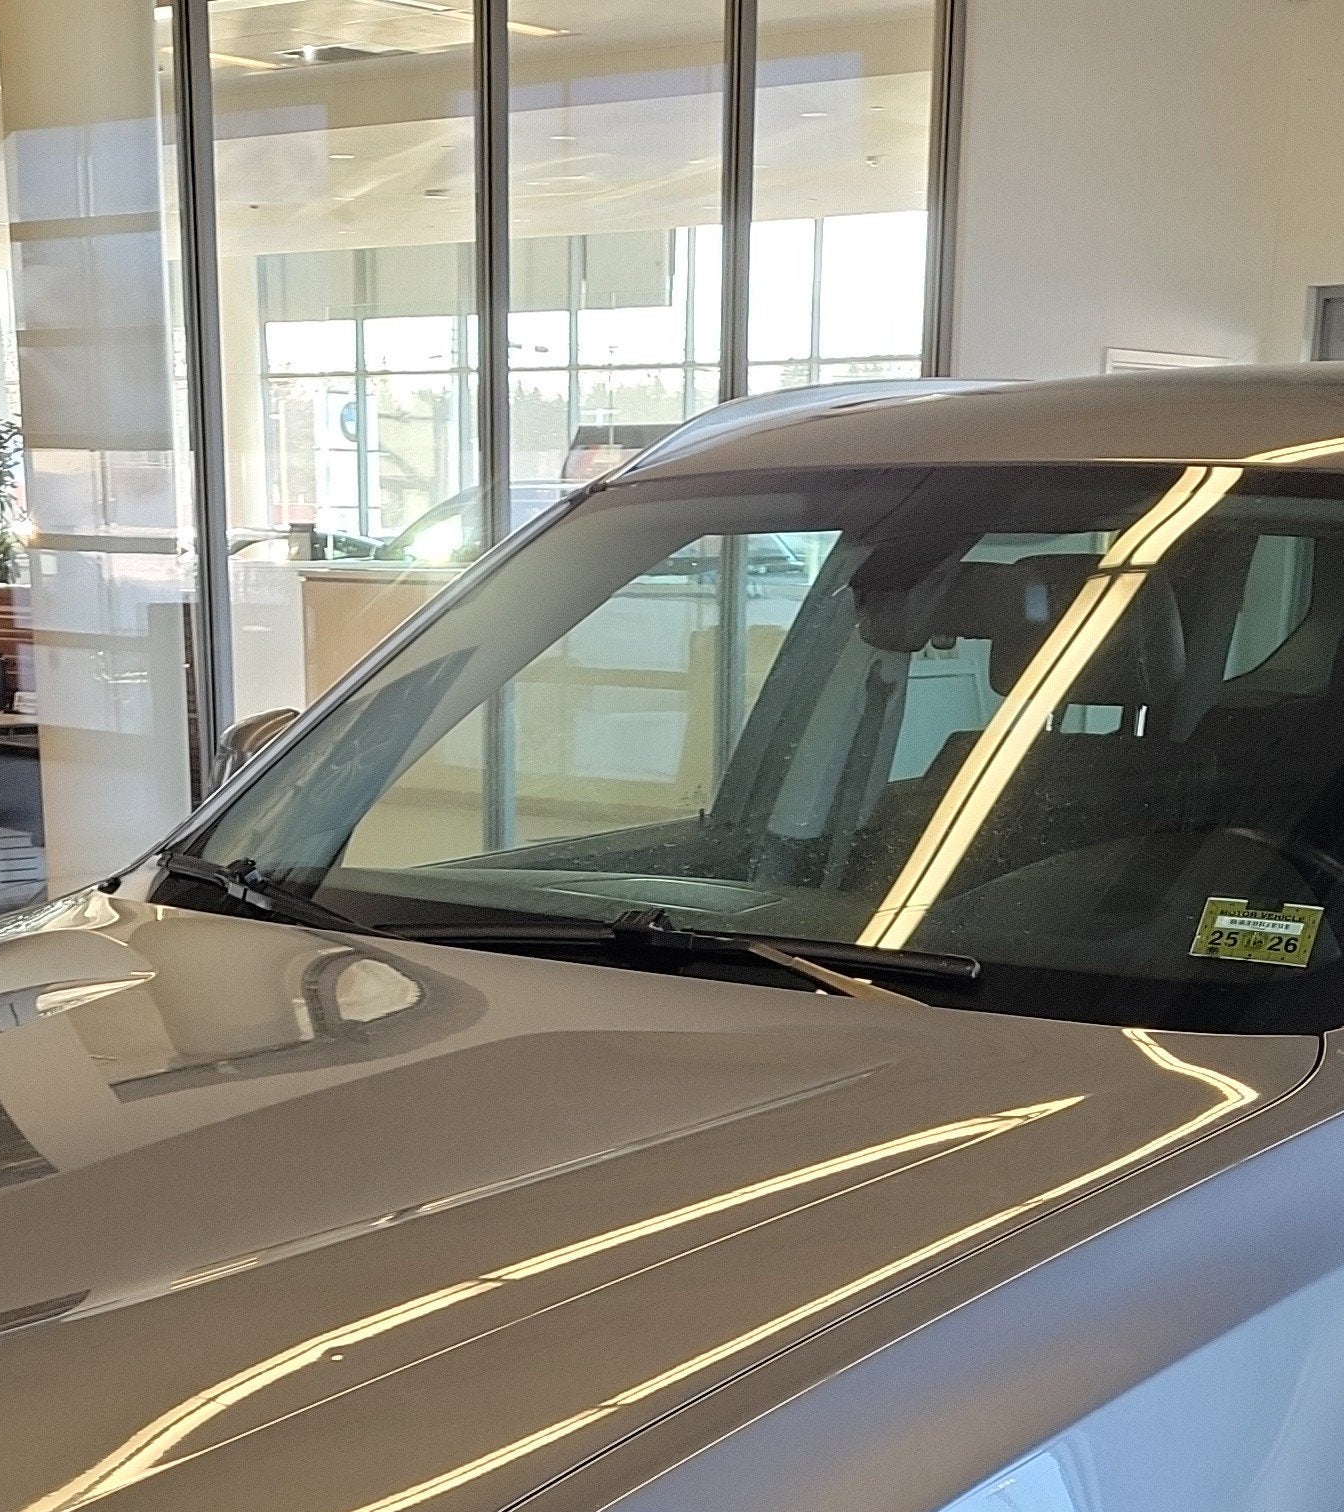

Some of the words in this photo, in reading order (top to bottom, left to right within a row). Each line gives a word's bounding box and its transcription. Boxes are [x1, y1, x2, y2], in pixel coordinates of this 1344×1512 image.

[1219, 909, 1257, 919] MOTOR
[1261, 912, 1305, 923] VEHICLE
[1208, 930, 1239, 947] 25
[1266, 935, 1299, 953] 26
